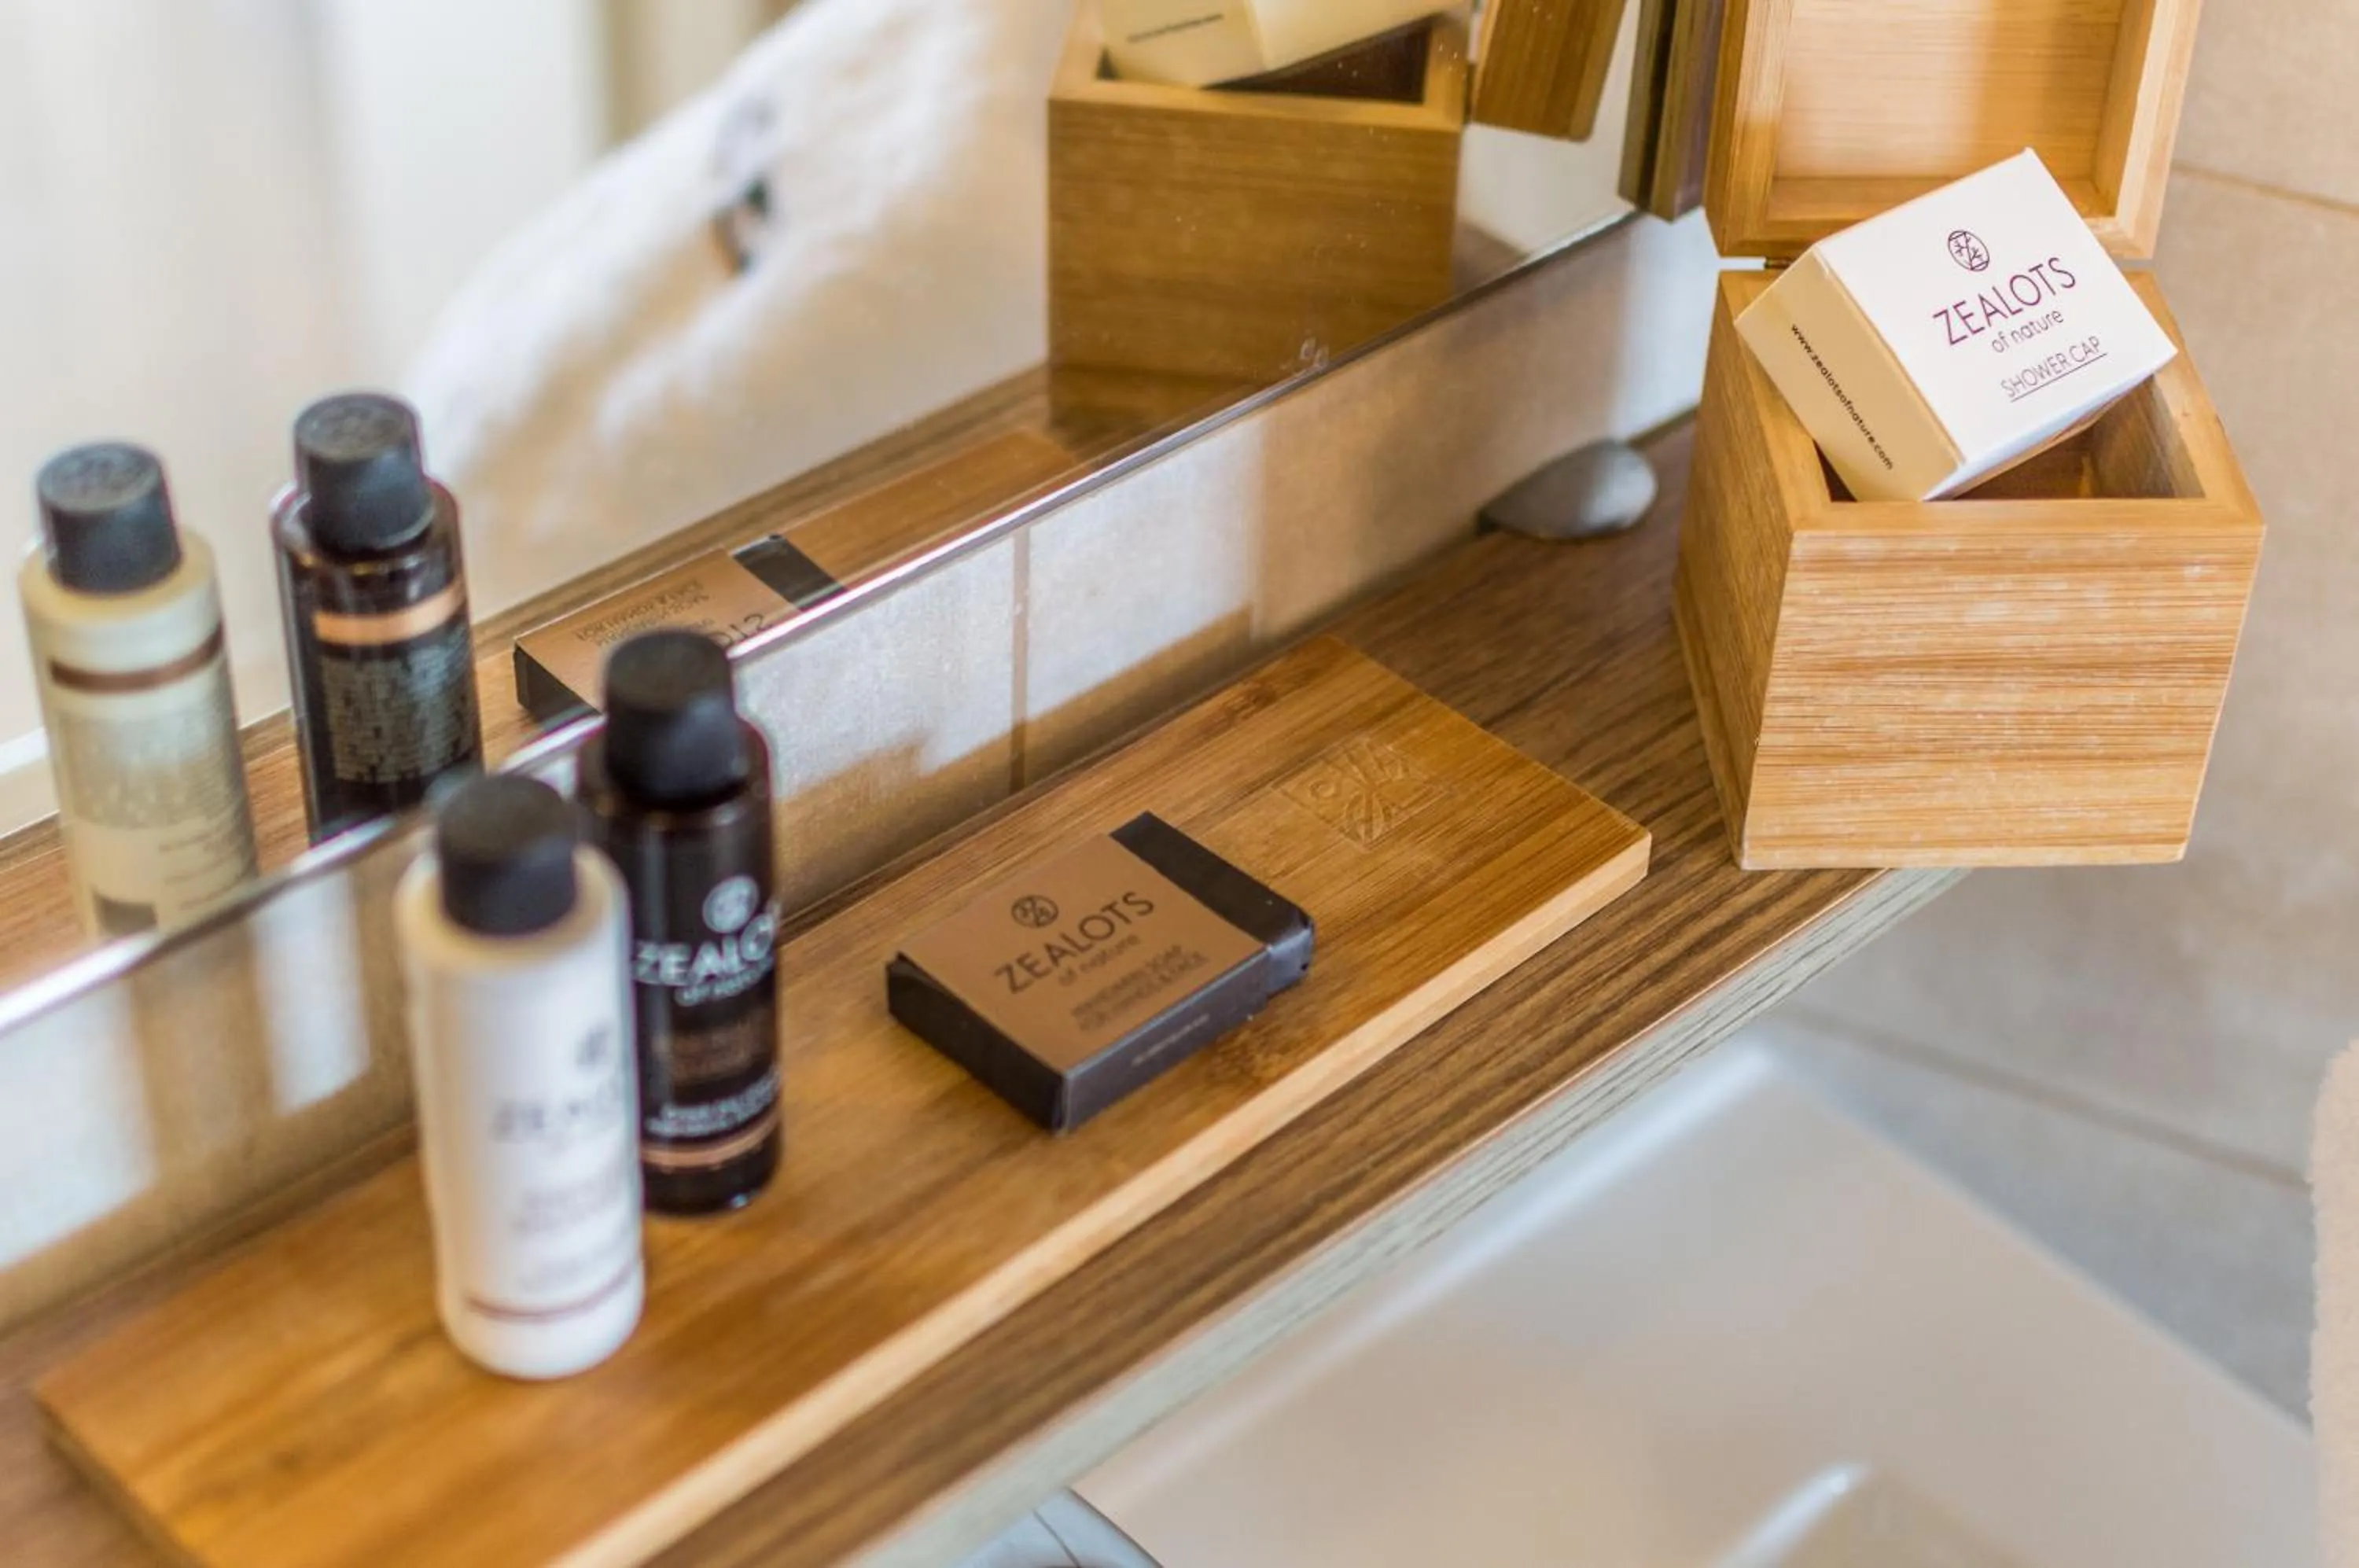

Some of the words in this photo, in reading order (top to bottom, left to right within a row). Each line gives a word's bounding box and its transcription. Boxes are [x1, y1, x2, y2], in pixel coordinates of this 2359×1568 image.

[1933, 257, 2077, 346] ZEALOTS
[1991, 332, 2011, 353] of
[2011, 309, 2065, 342] nature
[1790, 323, 1893, 470] www.zealotsofnature.com
[2000, 352, 2069, 399] SHOWER
[2069, 336, 2101, 363] CAP
[994, 892, 1155, 994] ZEALOTS
